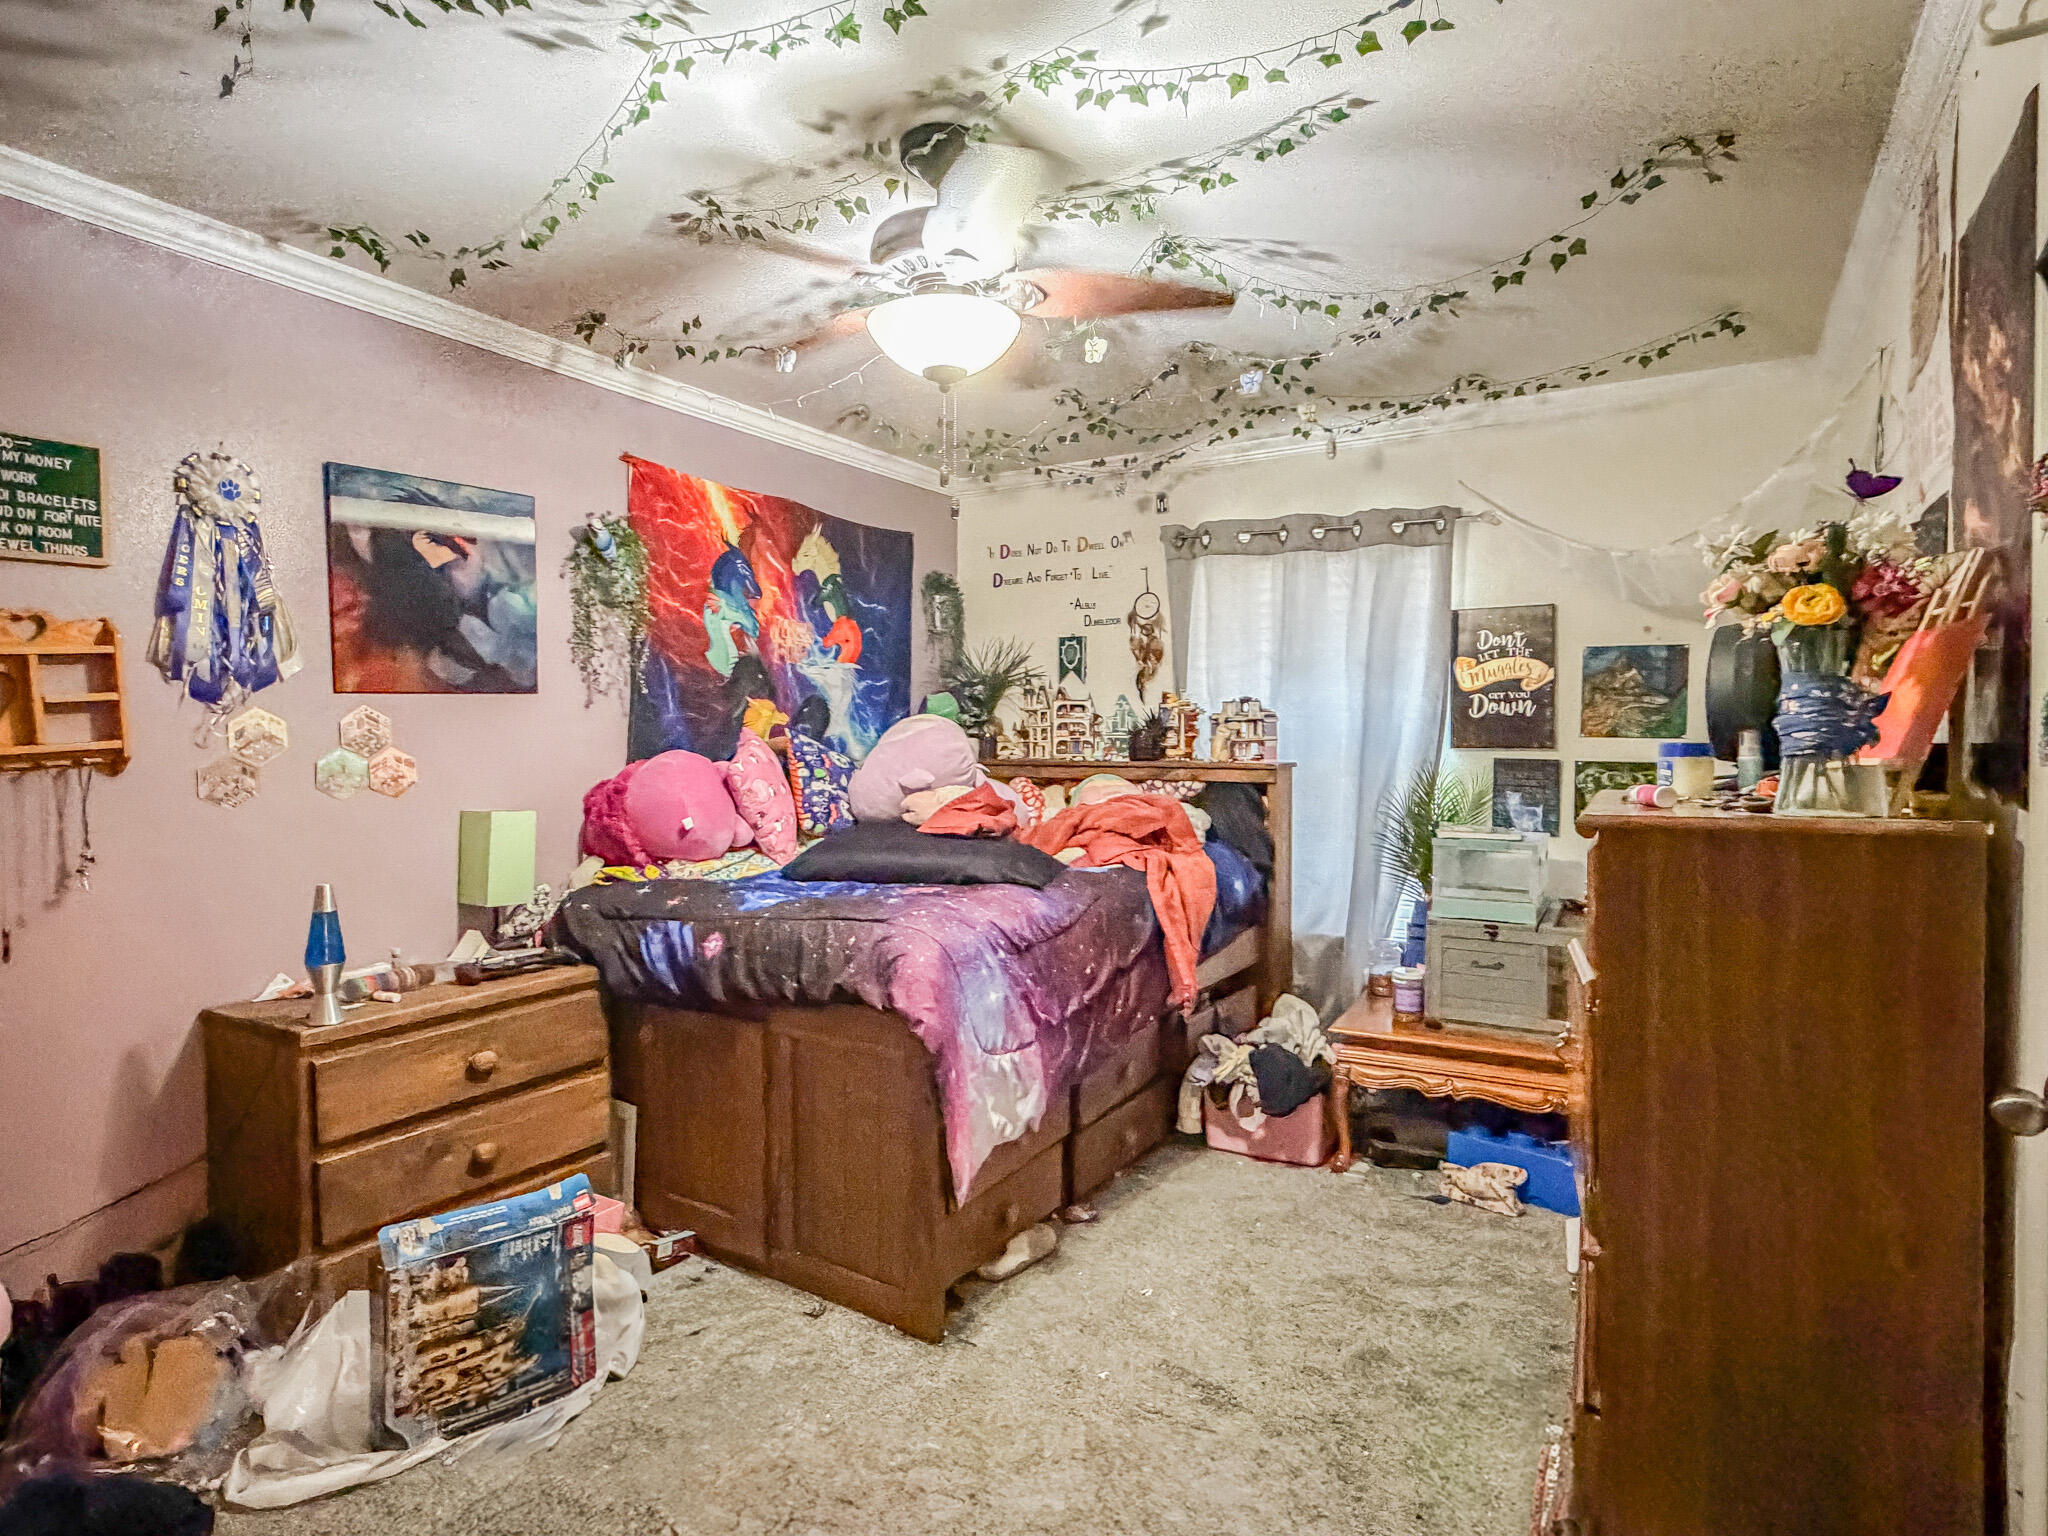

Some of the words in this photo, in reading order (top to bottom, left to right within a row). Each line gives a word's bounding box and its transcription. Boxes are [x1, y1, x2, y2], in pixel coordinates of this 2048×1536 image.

[2, 450, 21, 463] MY
[24, 453, 72, 471] MONEY
[0, 470, 37, 485] WORK
[17, 490, 97, 511] BRACELETS
[17, 507, 36, 520] ON
[15, 523, 33, 536] ON
[37, 525, 73, 539] ROOM
[40, 541, 88, 557] THINGS
[1478, 648, 1500, 662] LET
[1506, 646, 1533, 658] THE
[1468, 657, 1532, 685] Muggles
[1488, 692, 1506, 700] GET
[1507, 690, 1531, 699] YOU
[1468, 693, 1537, 718] Down
